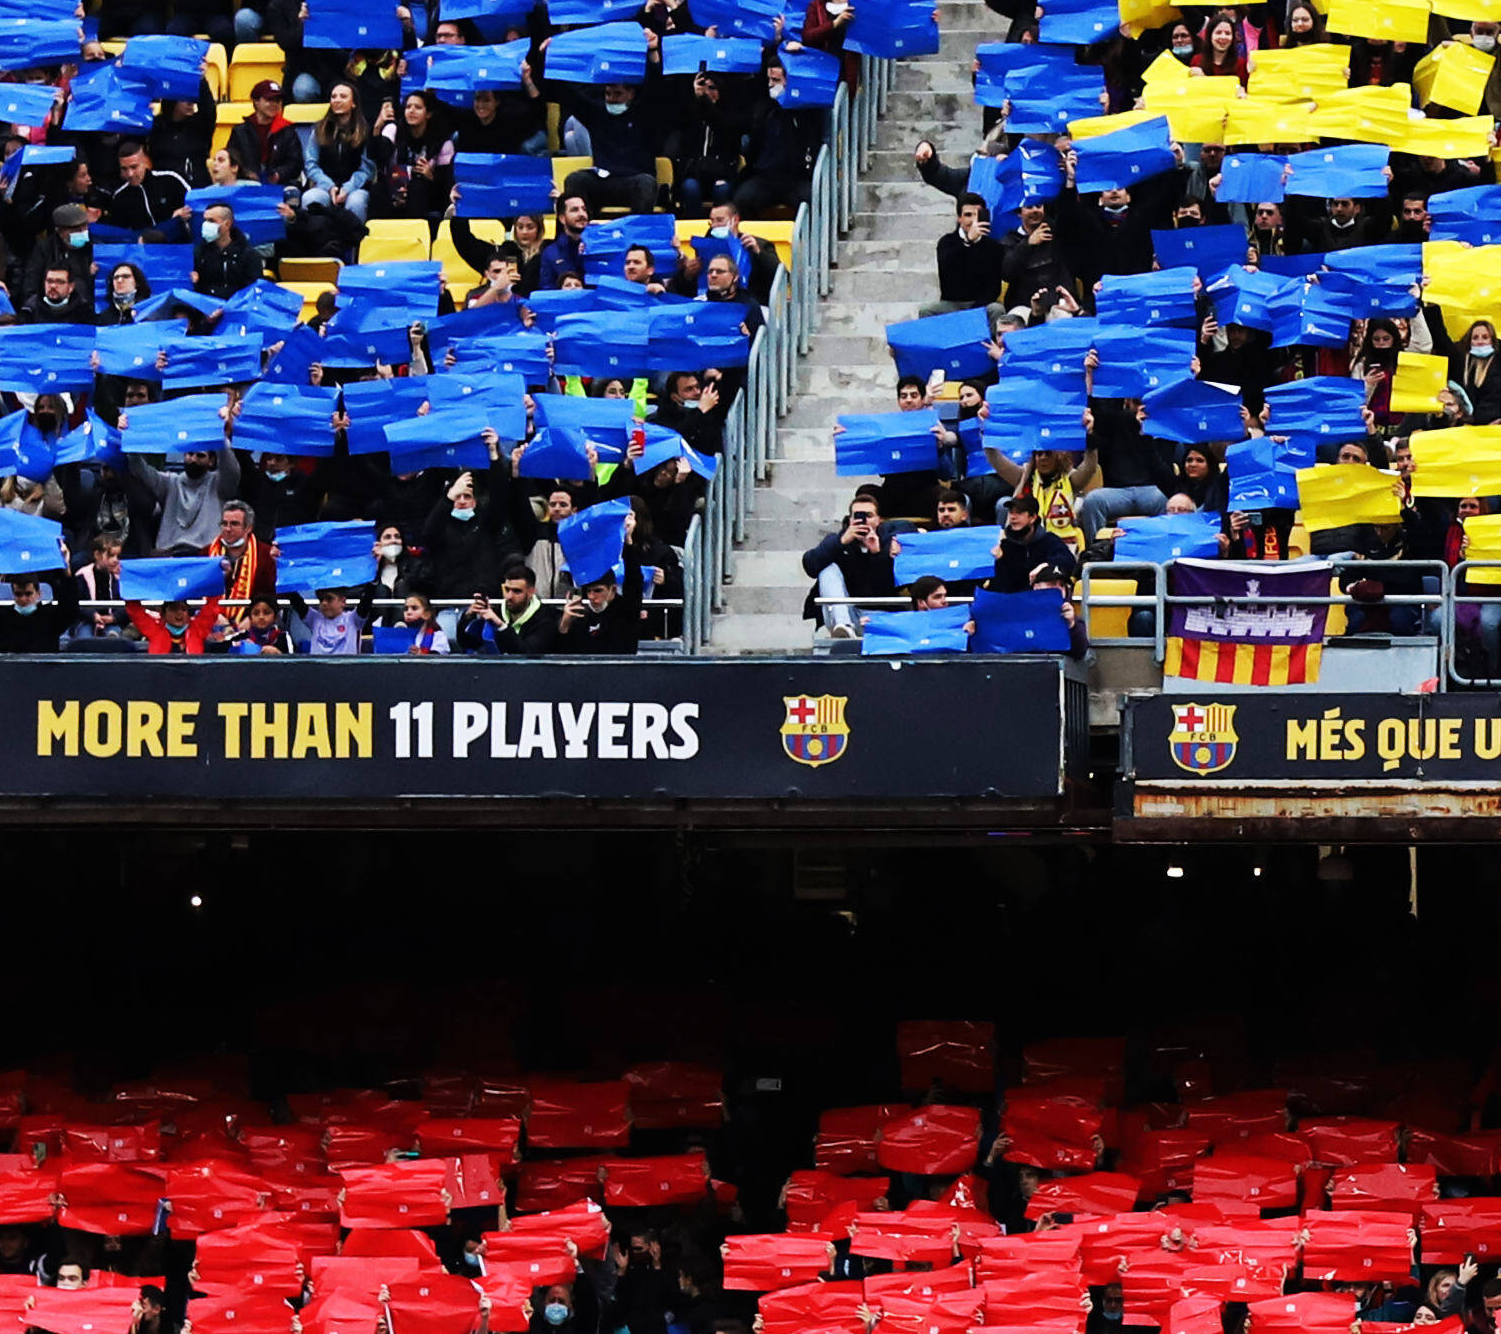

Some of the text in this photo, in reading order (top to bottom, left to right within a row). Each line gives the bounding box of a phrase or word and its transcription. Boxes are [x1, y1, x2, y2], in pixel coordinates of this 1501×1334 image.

[38, 699, 699, 760] MORE THAN 11 PLAYERS
[1287, 706, 1366, 760] MÉS
[1378, 718, 1462, 772] QUE
